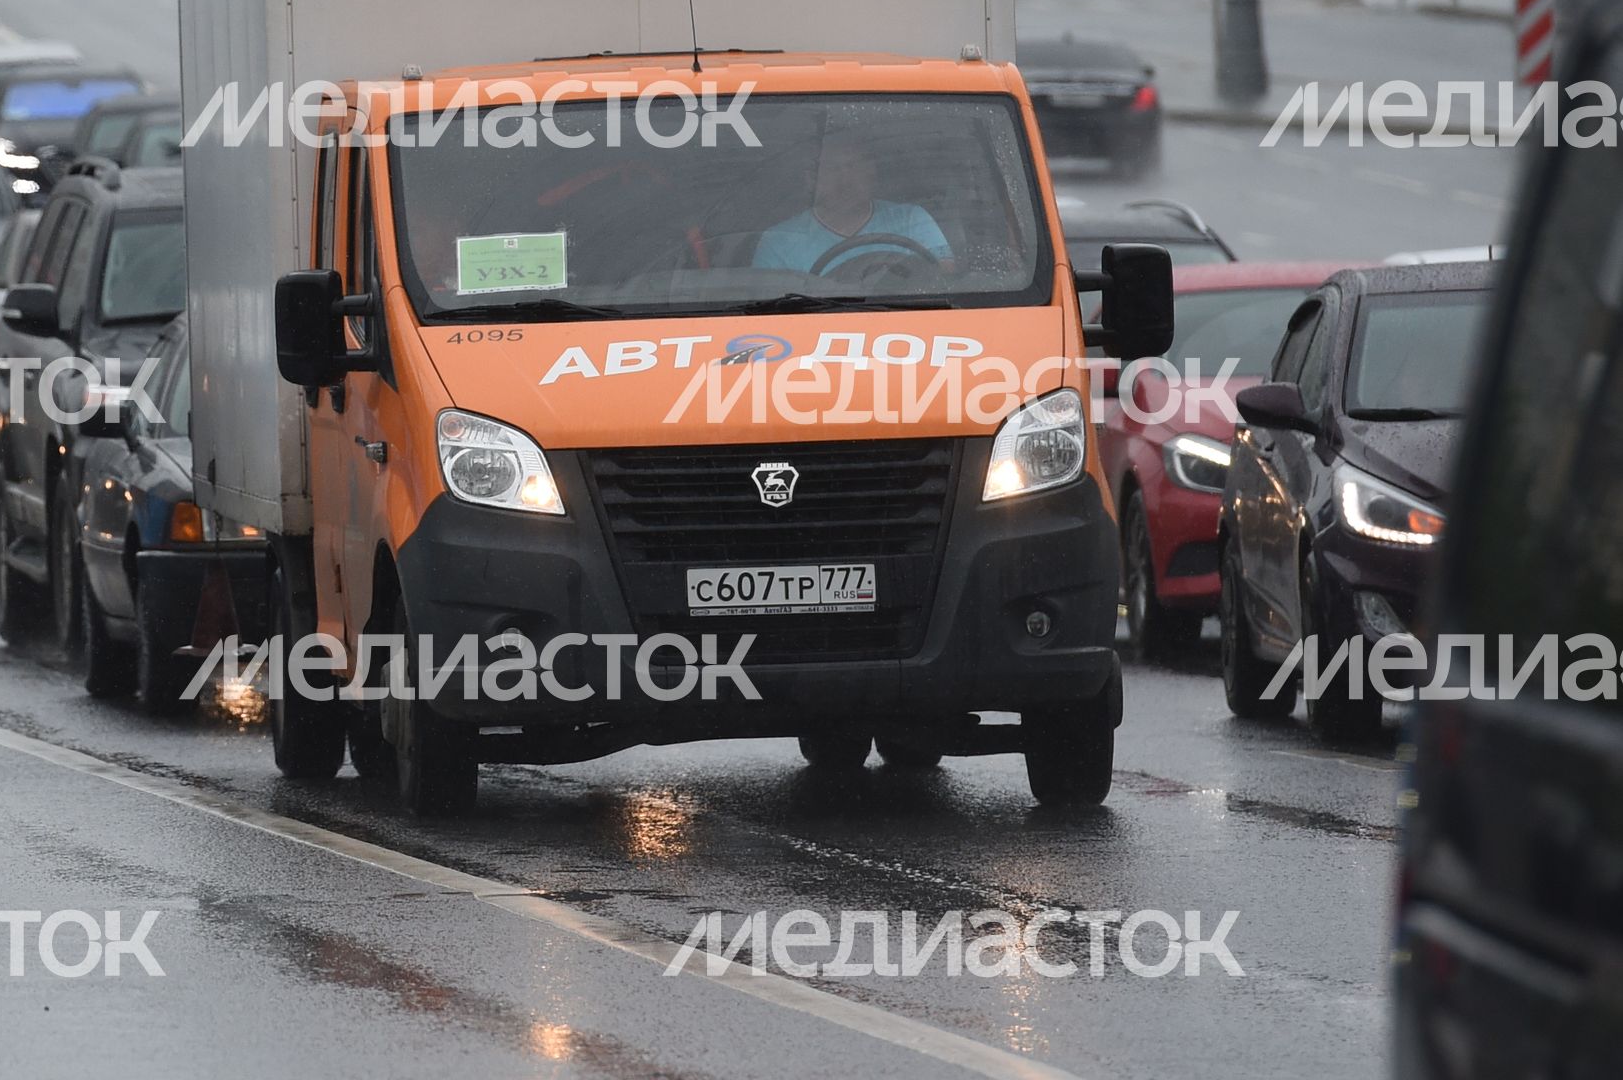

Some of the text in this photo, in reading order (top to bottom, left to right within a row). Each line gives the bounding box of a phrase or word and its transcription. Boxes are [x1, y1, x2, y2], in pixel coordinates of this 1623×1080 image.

[446, 328, 524, 345] 4095
[821, 567, 867, 591] 777
[833, 590, 857, 600] RUS
